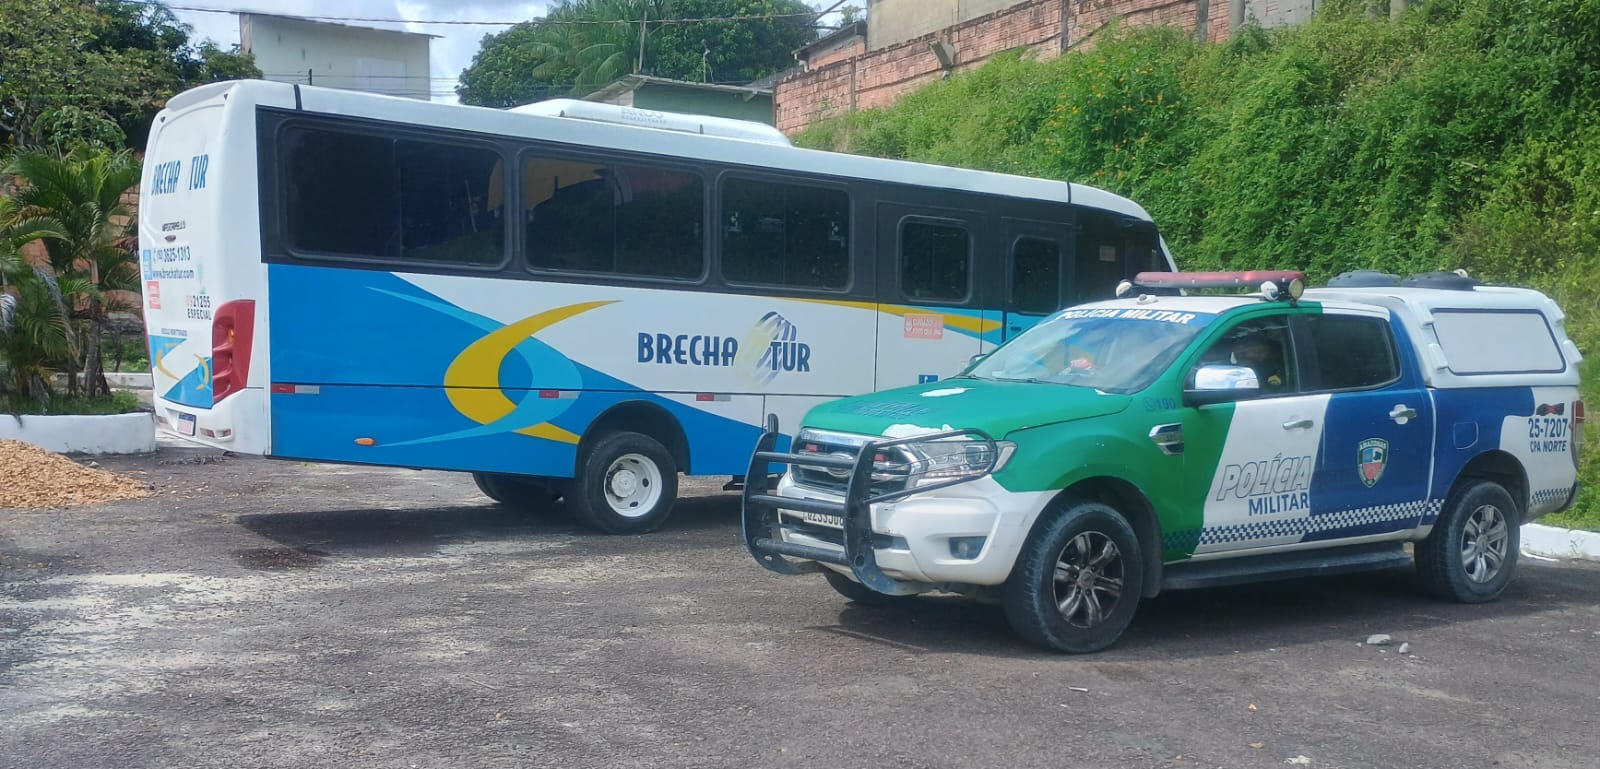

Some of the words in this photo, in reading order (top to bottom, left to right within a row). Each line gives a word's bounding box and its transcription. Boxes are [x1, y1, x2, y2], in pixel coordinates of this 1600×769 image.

[189, 154, 208, 190] TUR
[187, 308, 212, 321] ESPECIAL
[1119, 309, 1196, 325] MILITAR
[637, 332, 738, 367] BRECHA
[769, 341, 811, 372] TUR
[1528, 417, 1568, 438] 25-7207
[1542, 440, 1567, 452] NORTE
[1216, 452, 1311, 501] POLÍCIA
[1248, 492, 1309, 516] MILITAR
